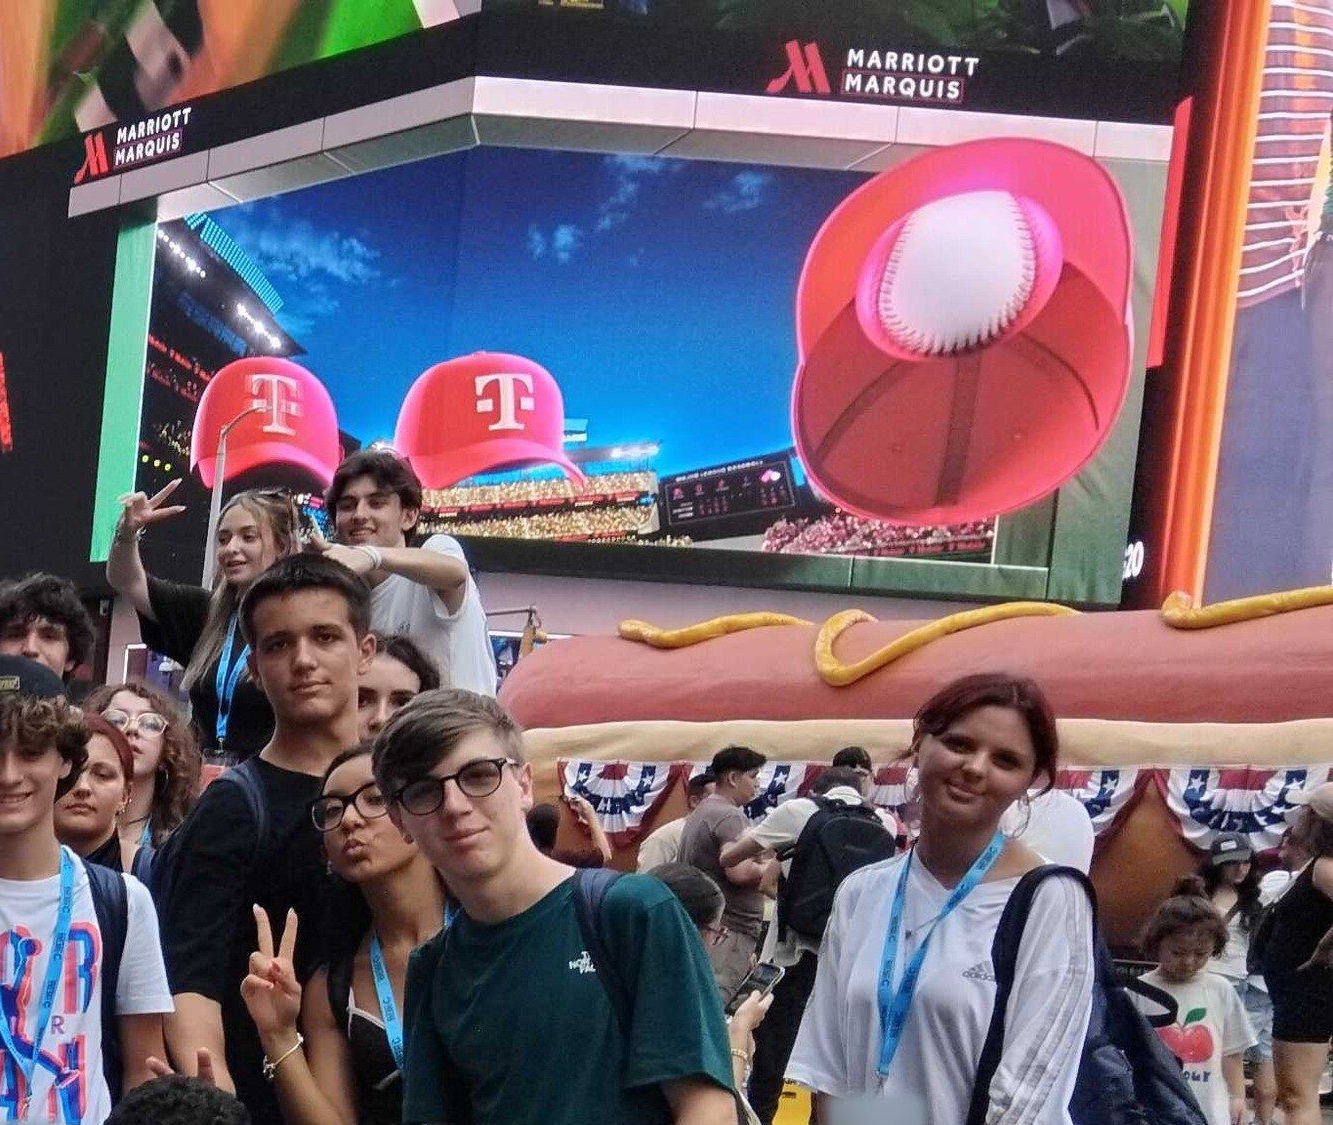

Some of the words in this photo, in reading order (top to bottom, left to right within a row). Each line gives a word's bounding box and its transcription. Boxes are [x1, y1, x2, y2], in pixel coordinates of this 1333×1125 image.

[846, 48, 980, 76] MARRIOTT
[845, 73, 960, 99] MARQUIS
[116, 107, 191, 145] MARRIOTT
[115, 132, 180, 166] MARQUIS
[475, 373, 534, 431] T
